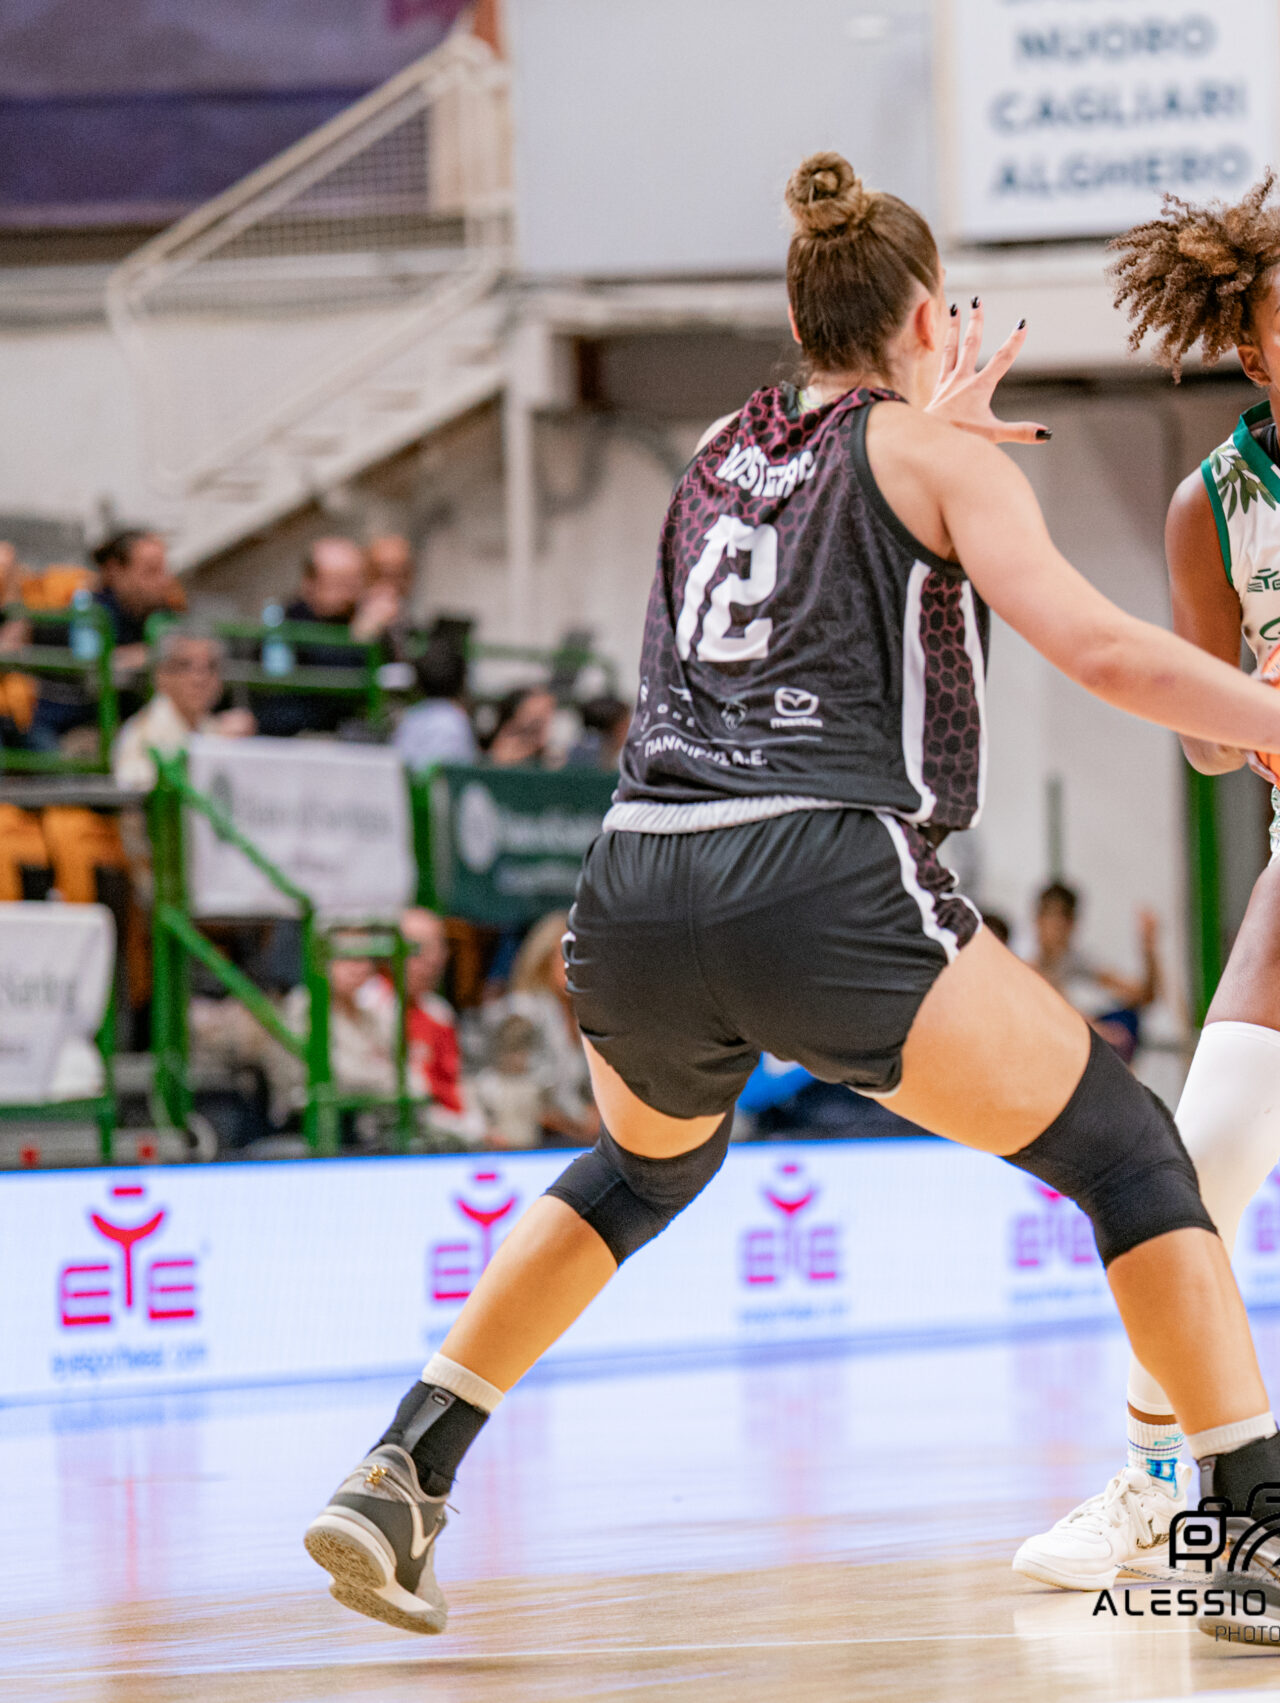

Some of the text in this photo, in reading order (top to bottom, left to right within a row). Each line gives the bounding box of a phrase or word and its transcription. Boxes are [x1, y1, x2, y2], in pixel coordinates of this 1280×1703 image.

[1016, 16, 1217, 60] NUORO
[988, 82, 1247, 134] CAGLIARI
[992, 145, 1252, 196] ALGHERO
[675, 514, 778, 662] 12
[59, 1187, 197, 1326] EYE
